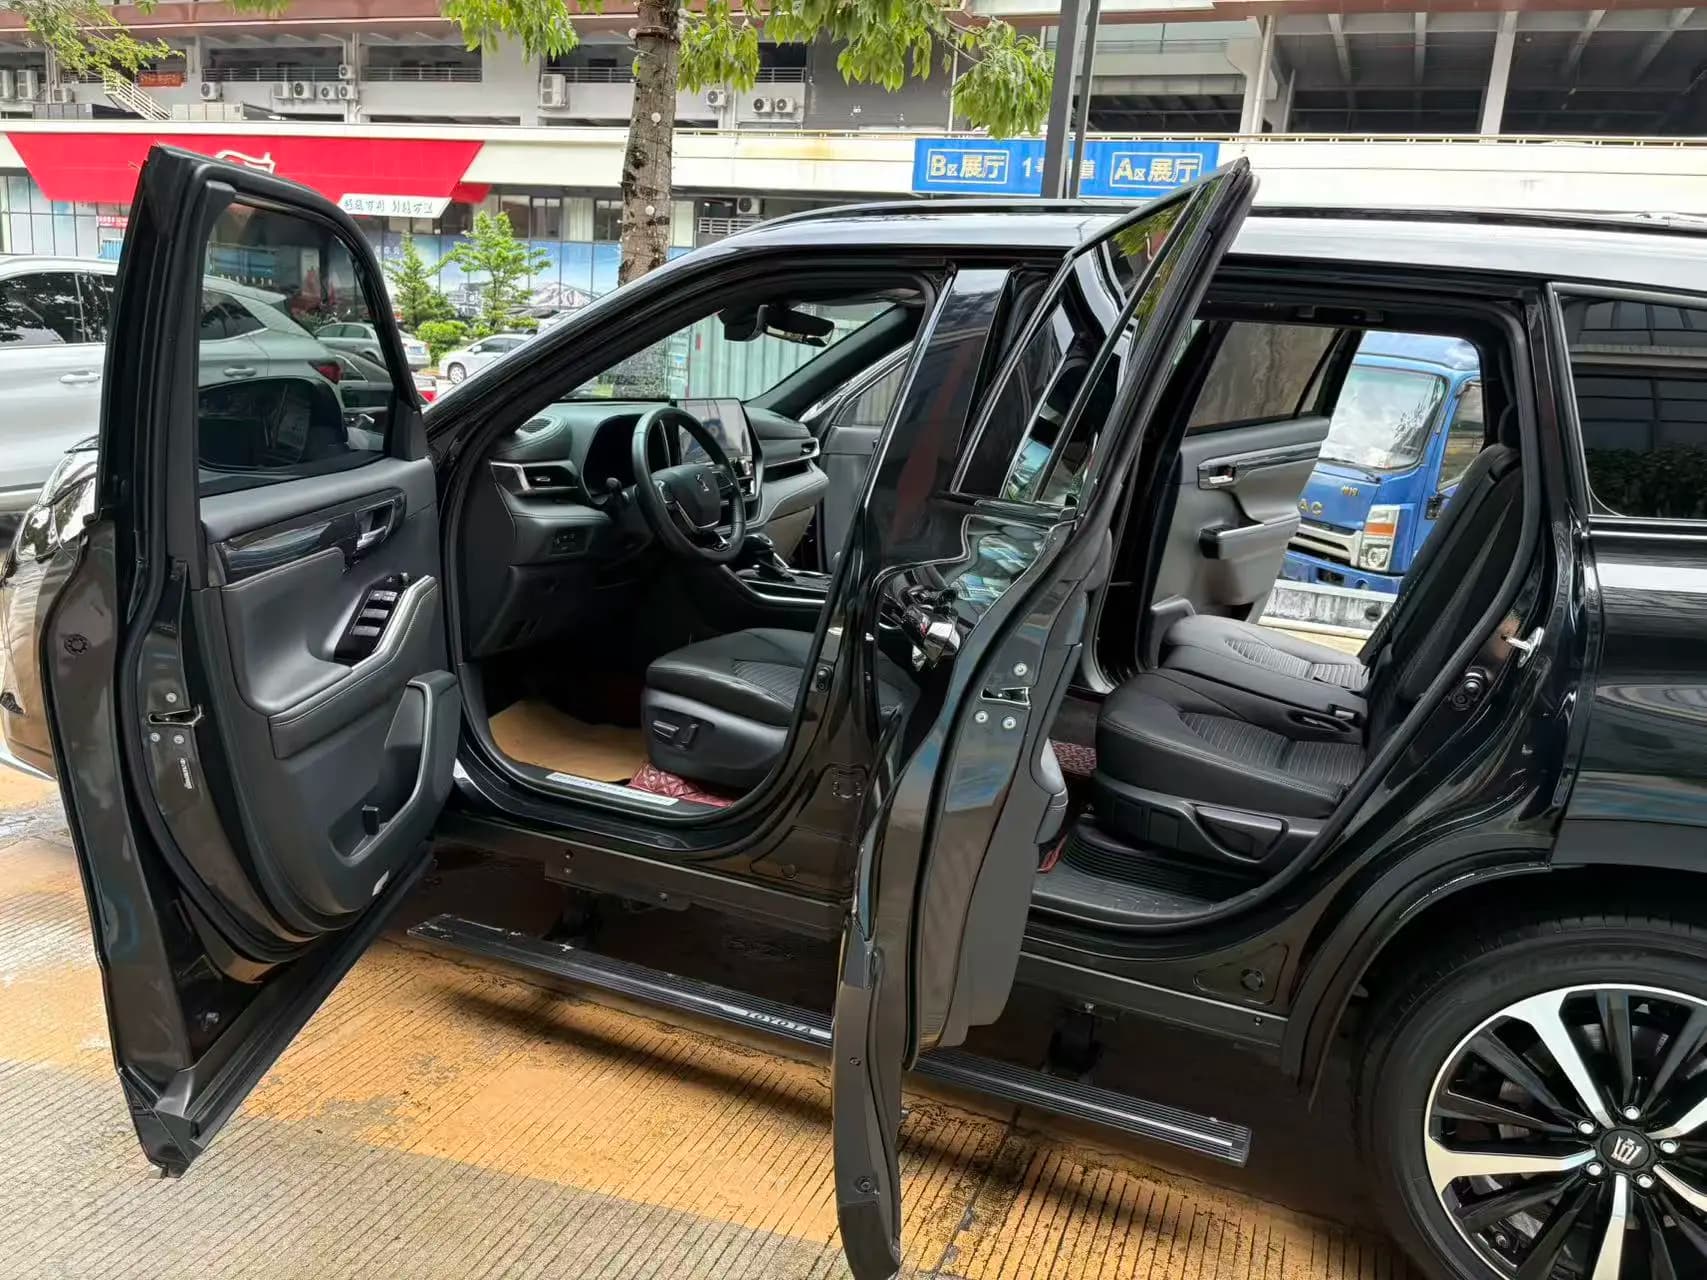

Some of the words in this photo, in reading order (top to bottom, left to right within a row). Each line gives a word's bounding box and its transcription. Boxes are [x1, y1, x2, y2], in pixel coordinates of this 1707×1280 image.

[930, 153, 1005, 179] B区展厅
[1114, 158, 1199, 183] A区展厅
